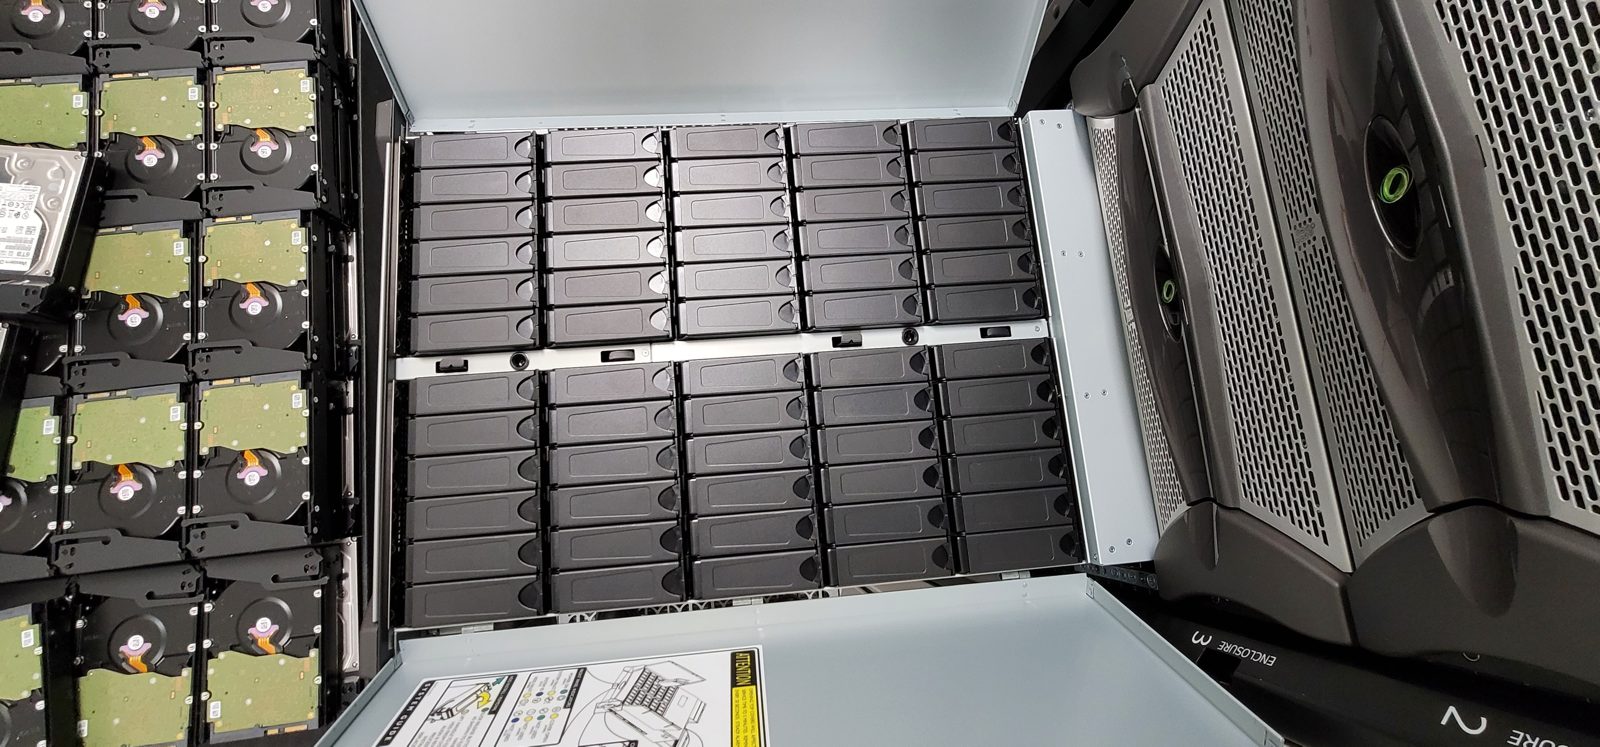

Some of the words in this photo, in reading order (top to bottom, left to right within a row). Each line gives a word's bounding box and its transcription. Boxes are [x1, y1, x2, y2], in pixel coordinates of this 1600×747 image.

[1191, 631, 1213, 646] 3
[1217, 640, 1277, 667] ENCLOSURE
[735, 652, 751, 686] ATTENTION
[406, 682, 431, 712] SYSTEM
[384, 714, 408, 742] GUIDE
[1440, 705, 1488, 735] 2
